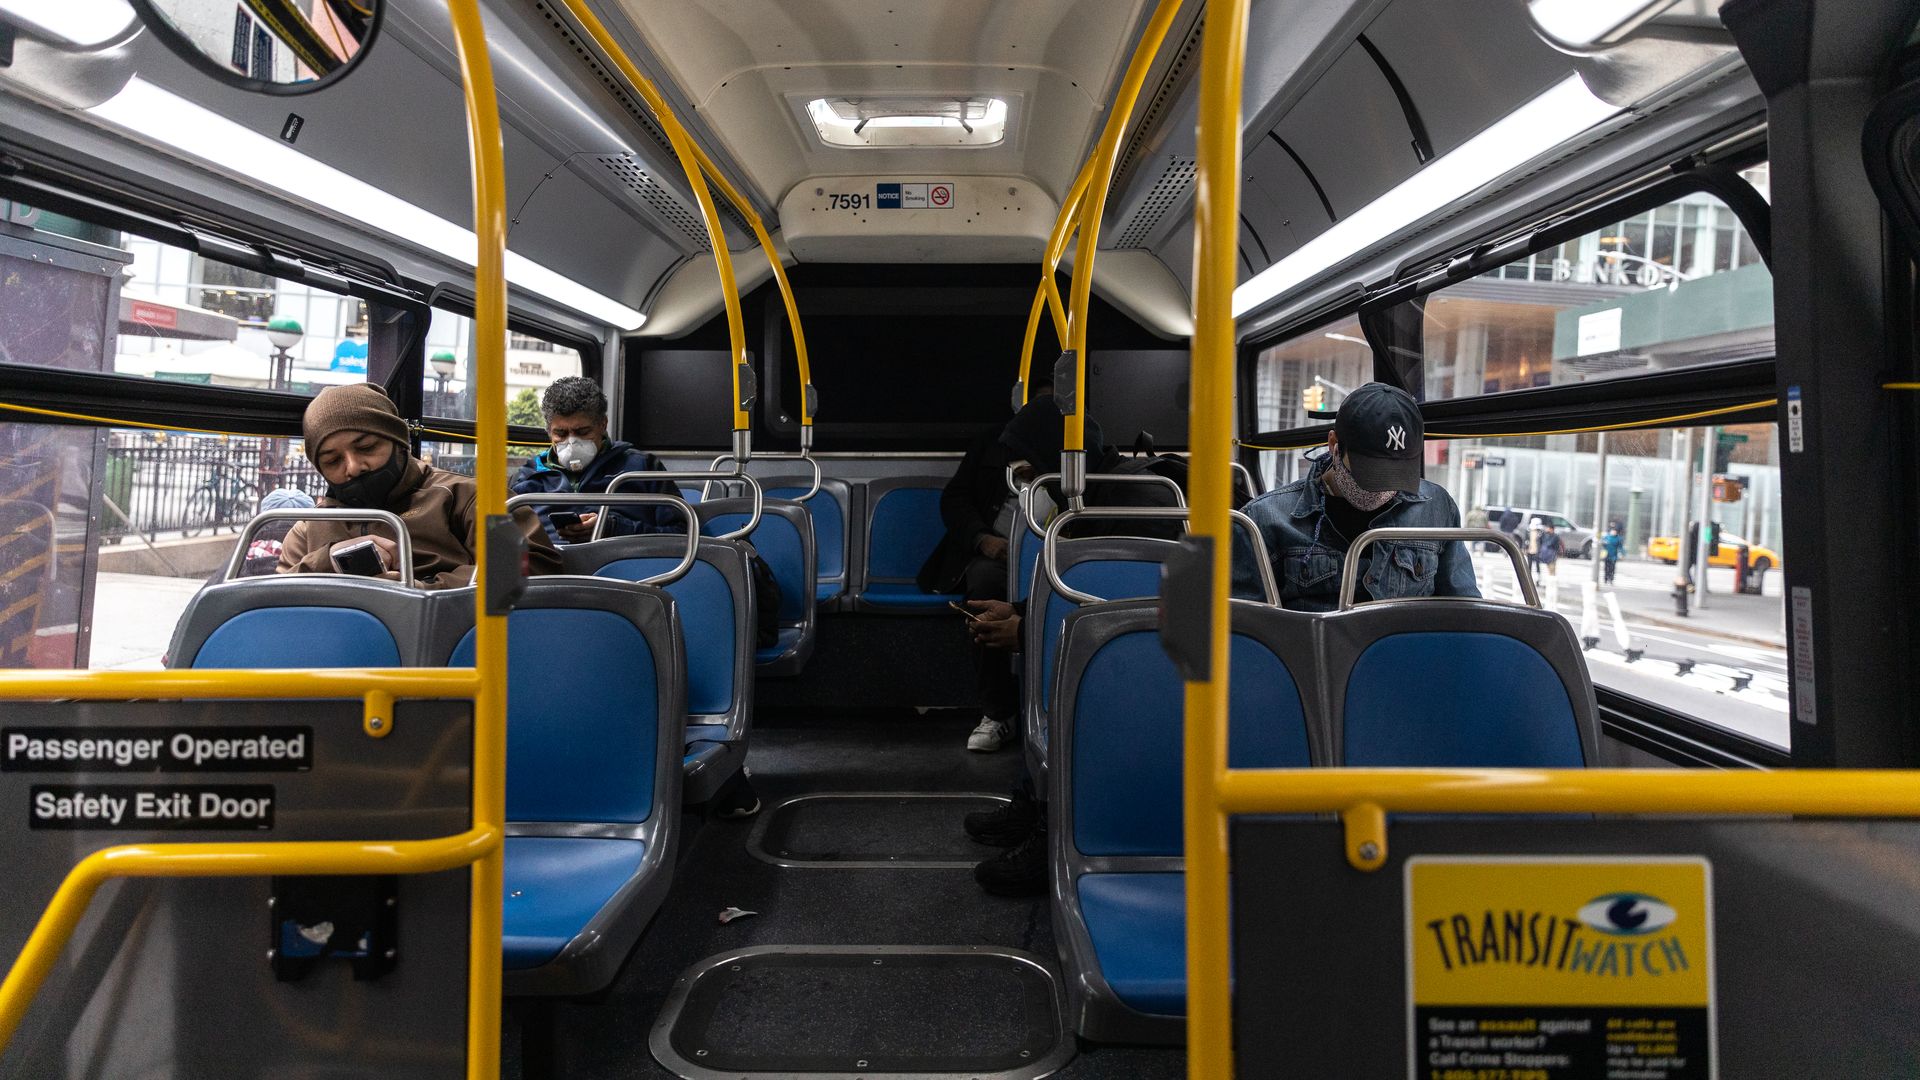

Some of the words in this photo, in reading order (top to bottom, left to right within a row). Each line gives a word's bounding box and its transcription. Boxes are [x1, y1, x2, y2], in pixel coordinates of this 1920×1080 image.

[829, 193, 870, 209] 7591
[878, 192, 900, 200] NOTICE
[1385, 425, 1406, 451] NY
[8, 733, 164, 765] Passenger
[170, 733, 305, 765] Operated
[35, 792, 127, 824] Safety
[136, 792, 191, 818] Exit
[200, 793, 271, 818] Door
[1428, 1017, 1455, 1032] See
[1458, 1020, 1476, 1031] an
[1479, 1017, 1536, 1032] assault
[1539, 1018, 1591, 1035] against
[1429, 1037, 1439, 1048] a
[1441, 1034, 1487, 1048] Transit
[1490, 1034, 1546, 1048] worker?
[1429, 1052, 1455, 1066] Call
[1459, 1052, 1500, 1066] Crime
[1504, 1052, 1570, 1068] Stoppers:
